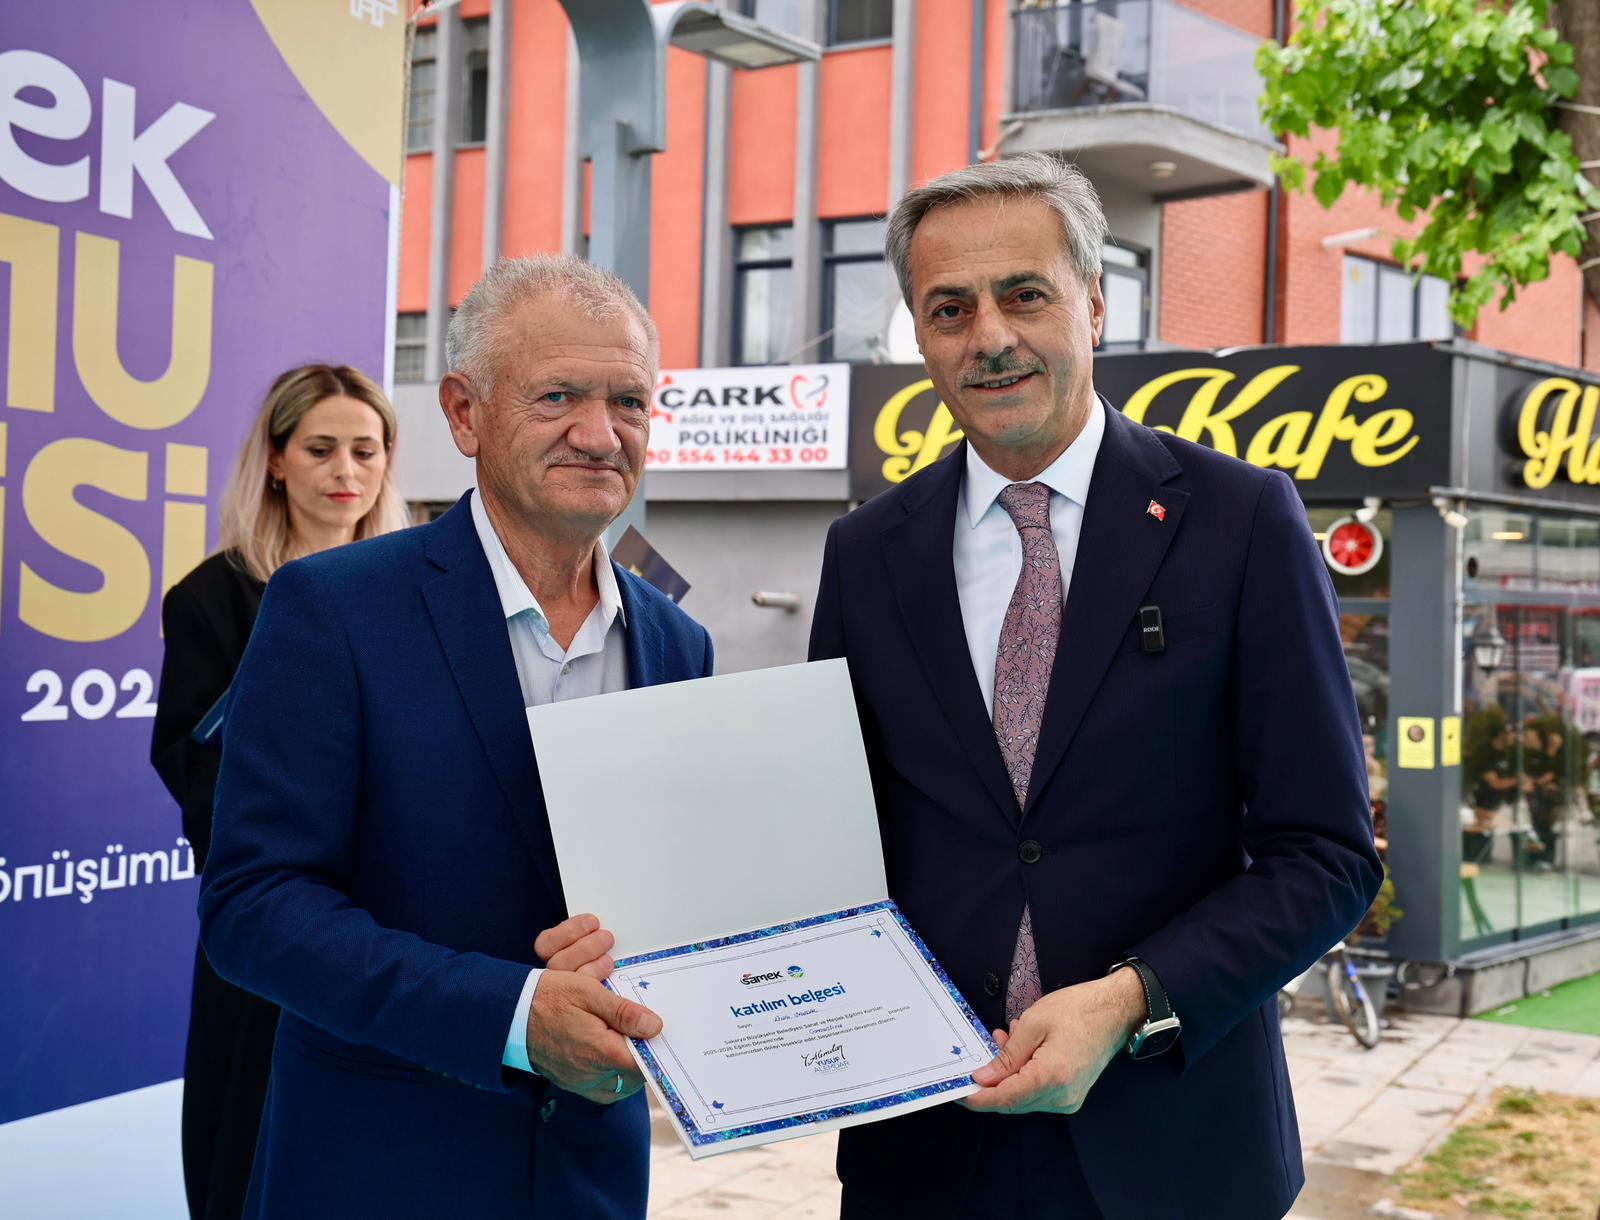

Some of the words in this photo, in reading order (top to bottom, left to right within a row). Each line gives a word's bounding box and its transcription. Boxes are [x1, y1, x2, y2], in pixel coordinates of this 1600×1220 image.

[720, 414, 735, 423] VE
[1121, 365, 1420, 479] Kafe
[678, 448, 716, 464] 554
[724, 448, 761, 464] 144
[768, 447, 793, 464] 33
[800, 447, 829, 463] 00
[21, 668, 158, 722] 202
[730, 1000, 787, 1018] katılım
[787, 982, 846, 1006] belgesi
[815, 1056, 841, 1066] YUSUF
